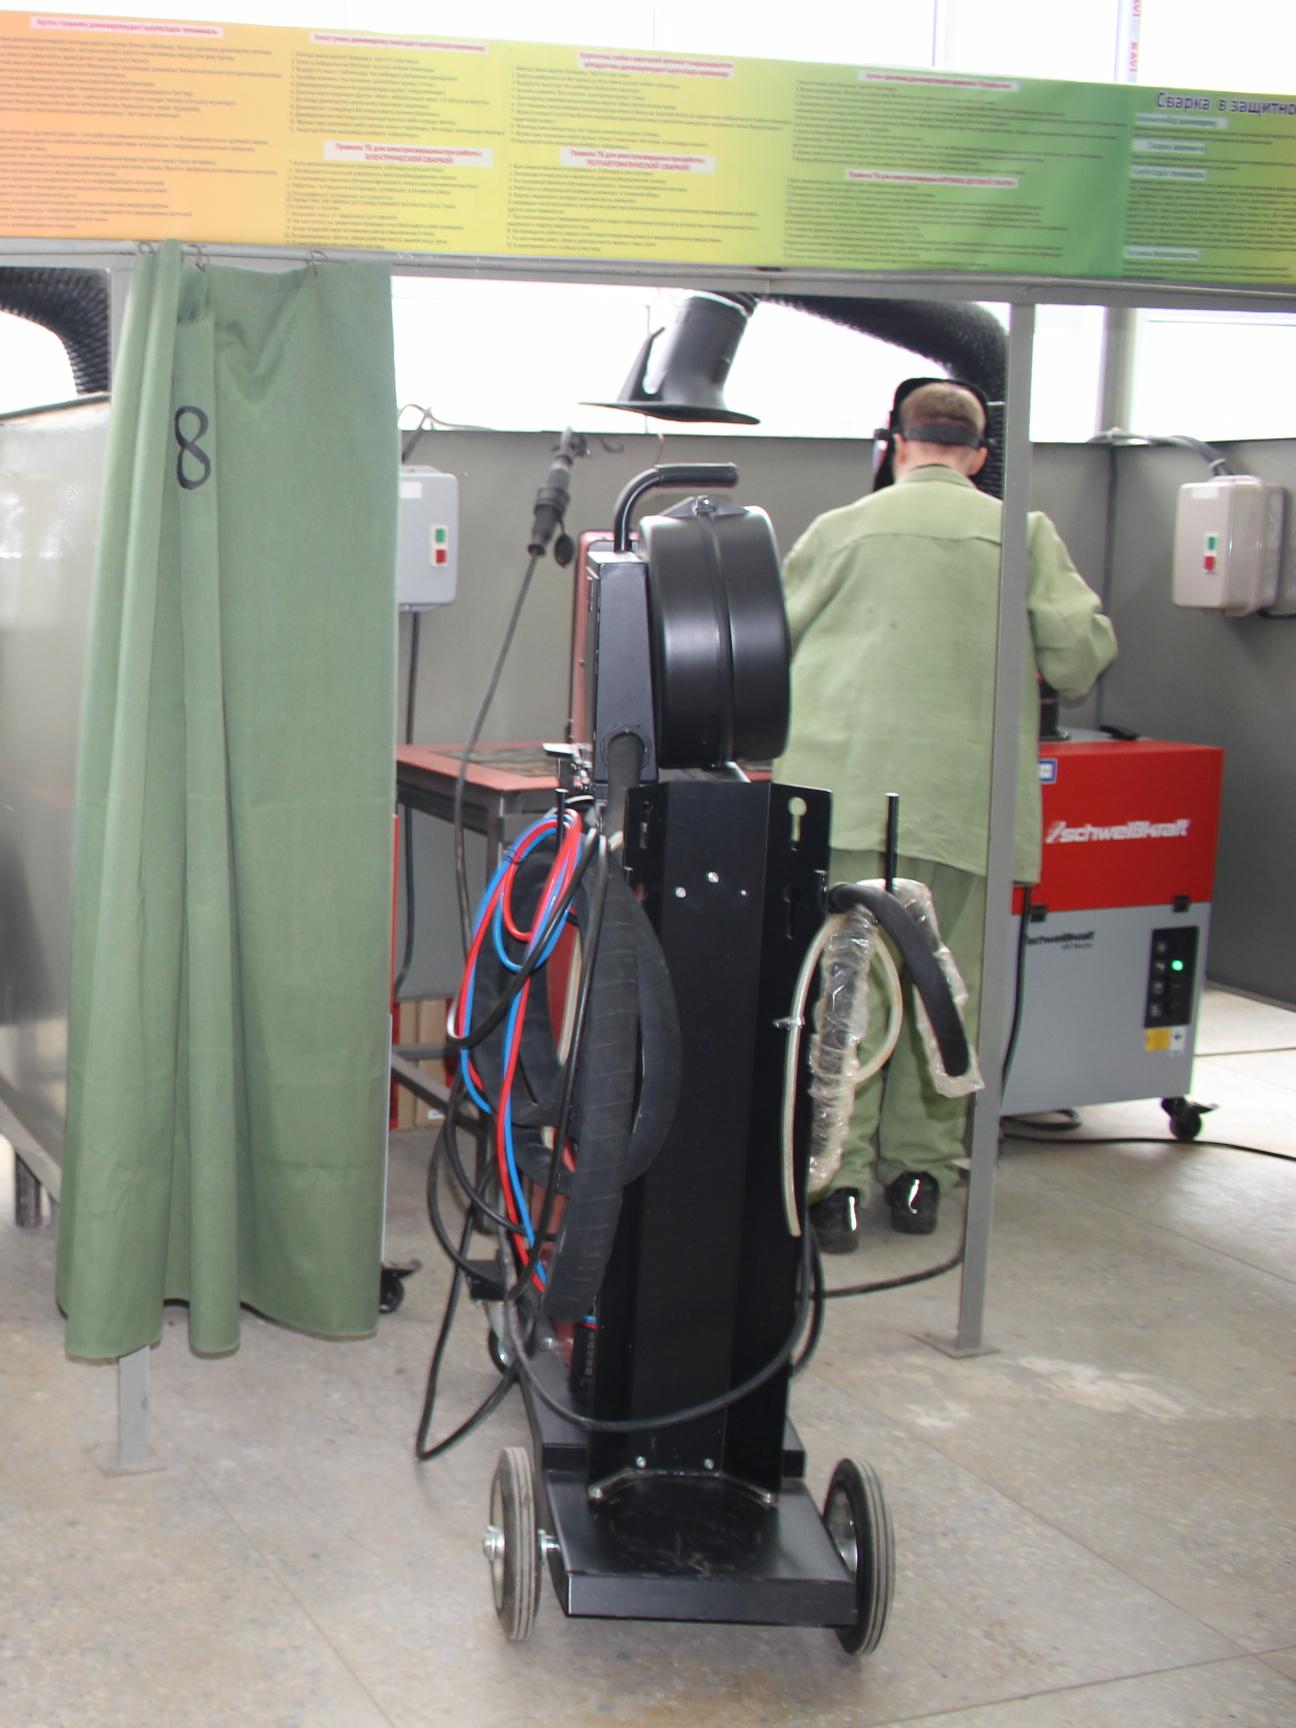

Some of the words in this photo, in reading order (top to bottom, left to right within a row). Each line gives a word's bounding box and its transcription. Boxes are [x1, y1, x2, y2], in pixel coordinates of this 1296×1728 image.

[1157, 92, 1210, 112] Сварка
[1218, 100, 1228, 112] в
[174, 405, 212, 490] 8
